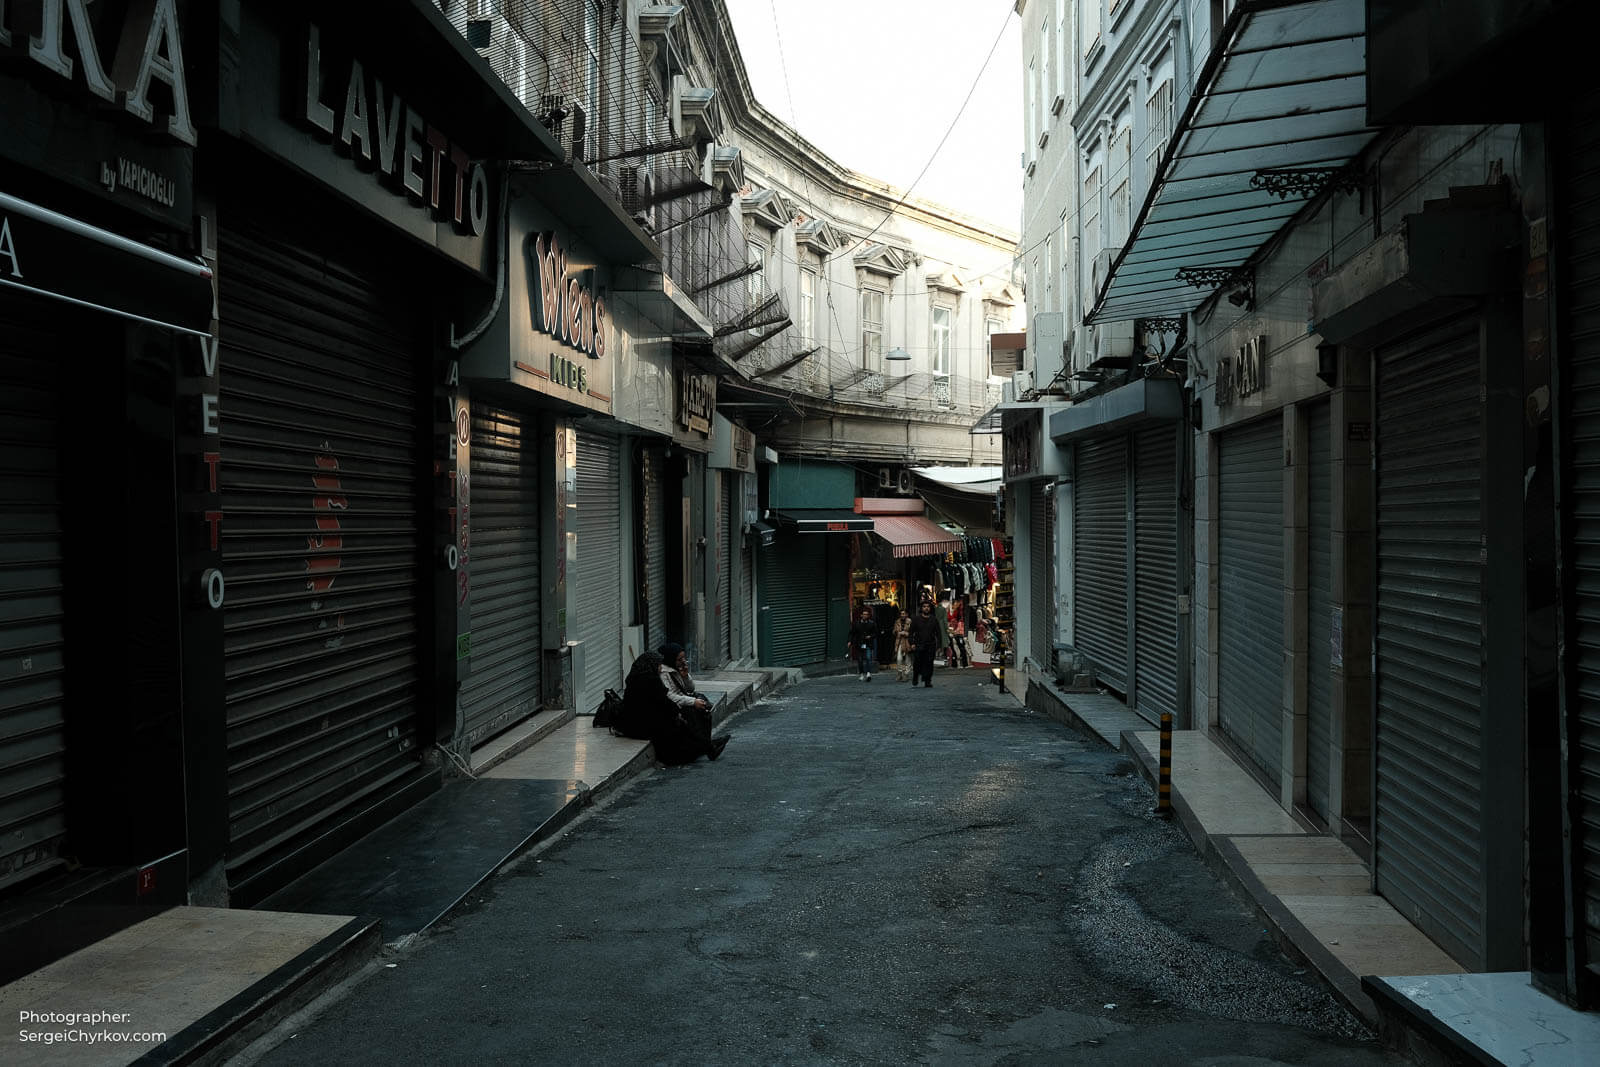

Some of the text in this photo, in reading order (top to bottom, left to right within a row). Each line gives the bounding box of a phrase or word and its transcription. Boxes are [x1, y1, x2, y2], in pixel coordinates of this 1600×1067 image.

[306, 22, 488, 237] LAVETTO
[102, 160, 117, 192] by
[550, 353, 587, 393] KIDS
